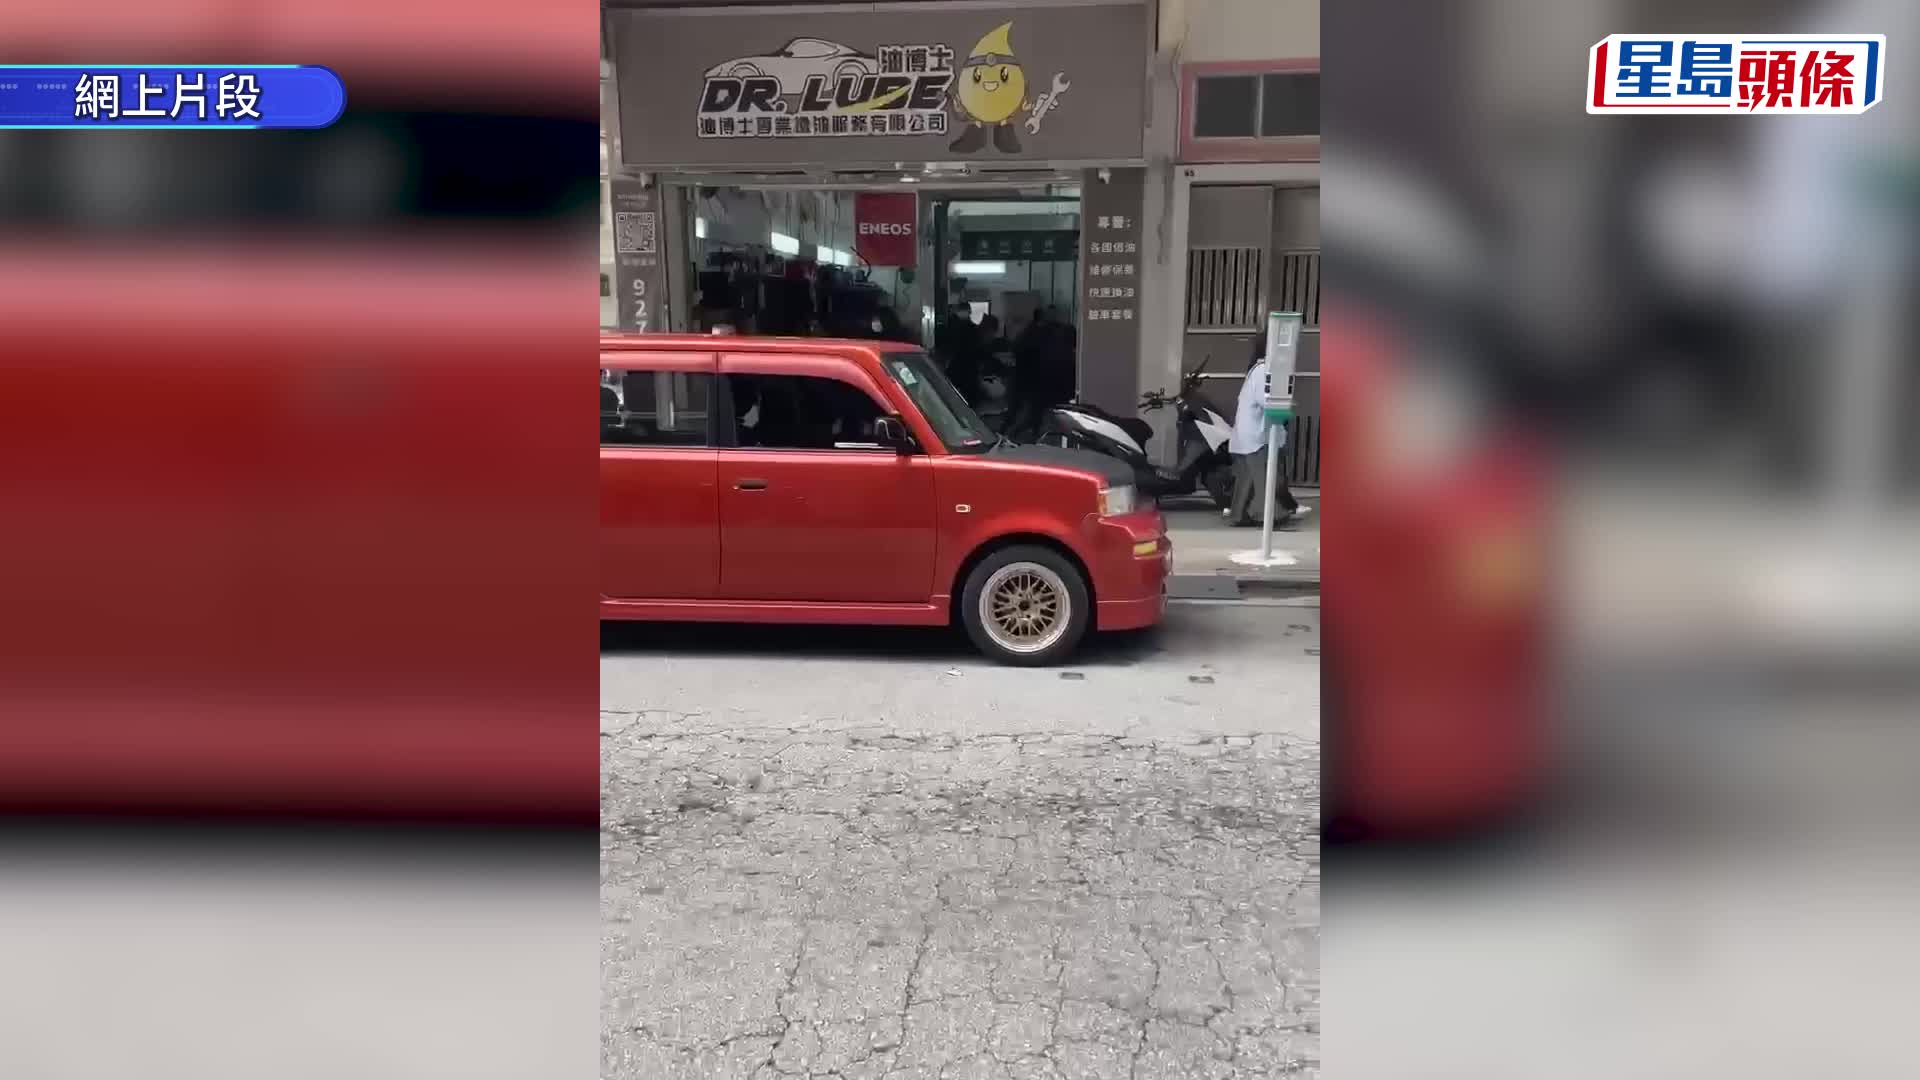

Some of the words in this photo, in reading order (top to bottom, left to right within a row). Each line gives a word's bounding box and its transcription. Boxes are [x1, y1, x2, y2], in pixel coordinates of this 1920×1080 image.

[881, 47, 952, 73] 油博士
[700, 76, 787, 112] DR.
[799, 75, 953, 111] LUBE
[859, 223, 912, 236] ENEOS
